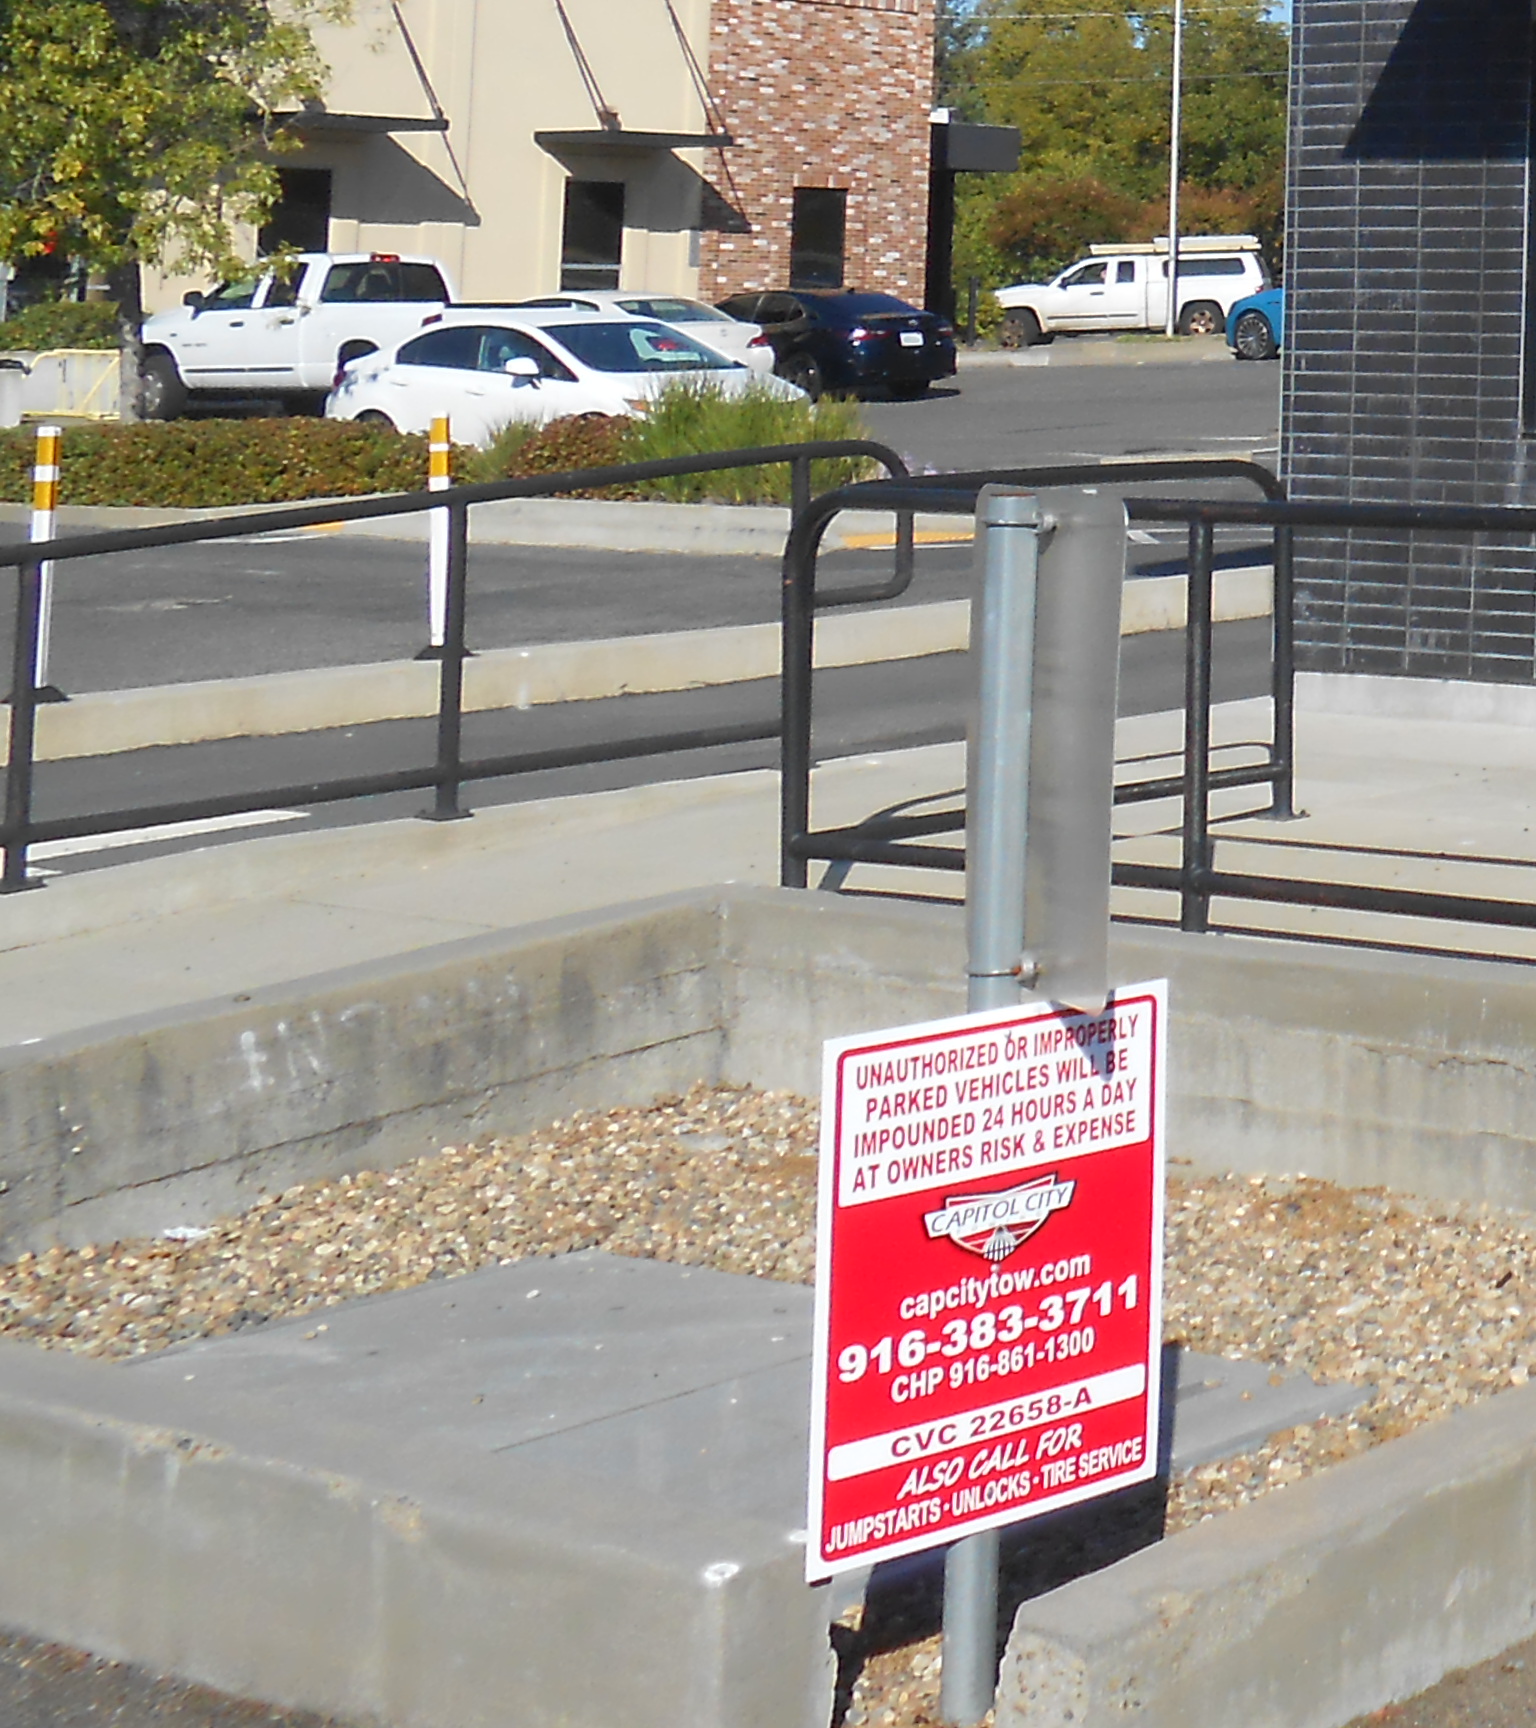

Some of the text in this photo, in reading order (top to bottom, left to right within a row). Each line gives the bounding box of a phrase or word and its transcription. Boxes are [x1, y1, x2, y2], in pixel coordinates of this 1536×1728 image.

[857, 1014, 1139, 1090] UNAUTHORIZED OR IMPROPERLY
[866, 1048, 1128, 1122] PARKED VEHICLES WILL BE
[852, 1110, 1136, 1193] AT OWNERS RISK & EXPENSE
[854, 1078, 1137, 1158] IMPOUNDED 24 HOURS A DAY
[931, 1199, 1019, 1232] CAPITOL
[1025, 1186, 1068, 1211] CITY
[900, 1254, 1091, 1320] capcitytow.com
[837, 1274, 1138, 1383] 916-383-3711
[891, 1326, 1094, 1403] CHP 916-861-1300
[891, 1387, 1092, 1458] CVC 22658-A
[825, 1436, 1143, 1553] JUMPSTARTS UNLOCKS TIRE SERVICE
[897, 1423, 1084, 1501] ALSO CALL FOR
